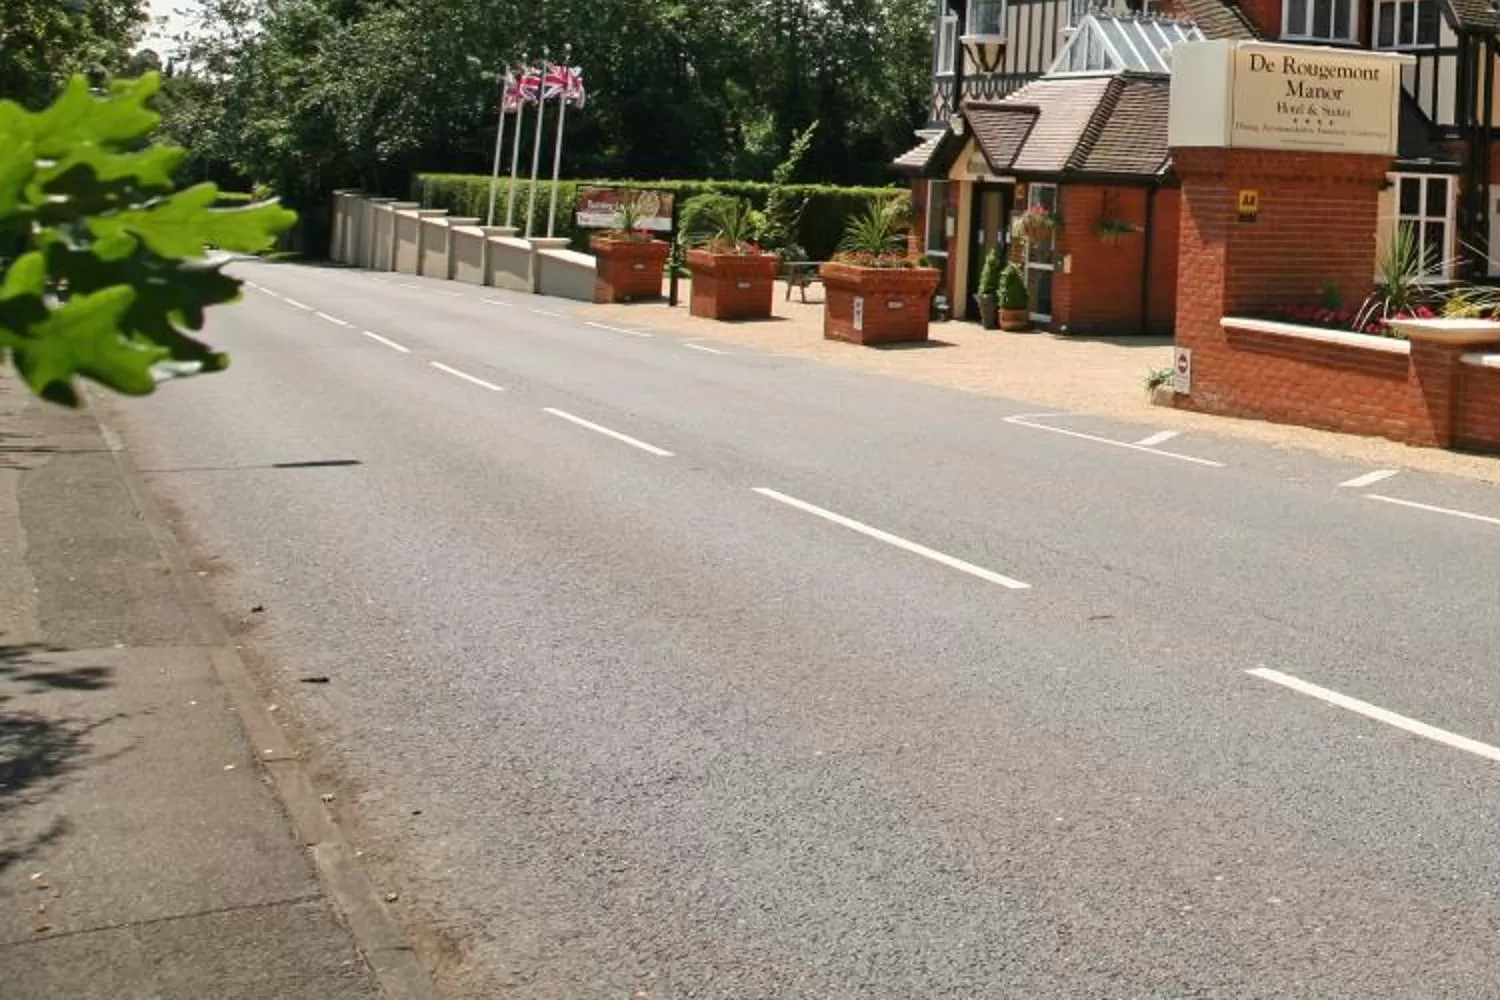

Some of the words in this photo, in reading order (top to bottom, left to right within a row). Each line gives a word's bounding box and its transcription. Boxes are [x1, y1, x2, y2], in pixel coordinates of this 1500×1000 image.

[1250, 53, 1275, 73] De
[1282, 55, 1380, 81] Rougemont
[1285, 79, 1344, 101] Manor
[1276, 101, 1304, 115] Hotel
[1308, 104, 1319, 116] &
